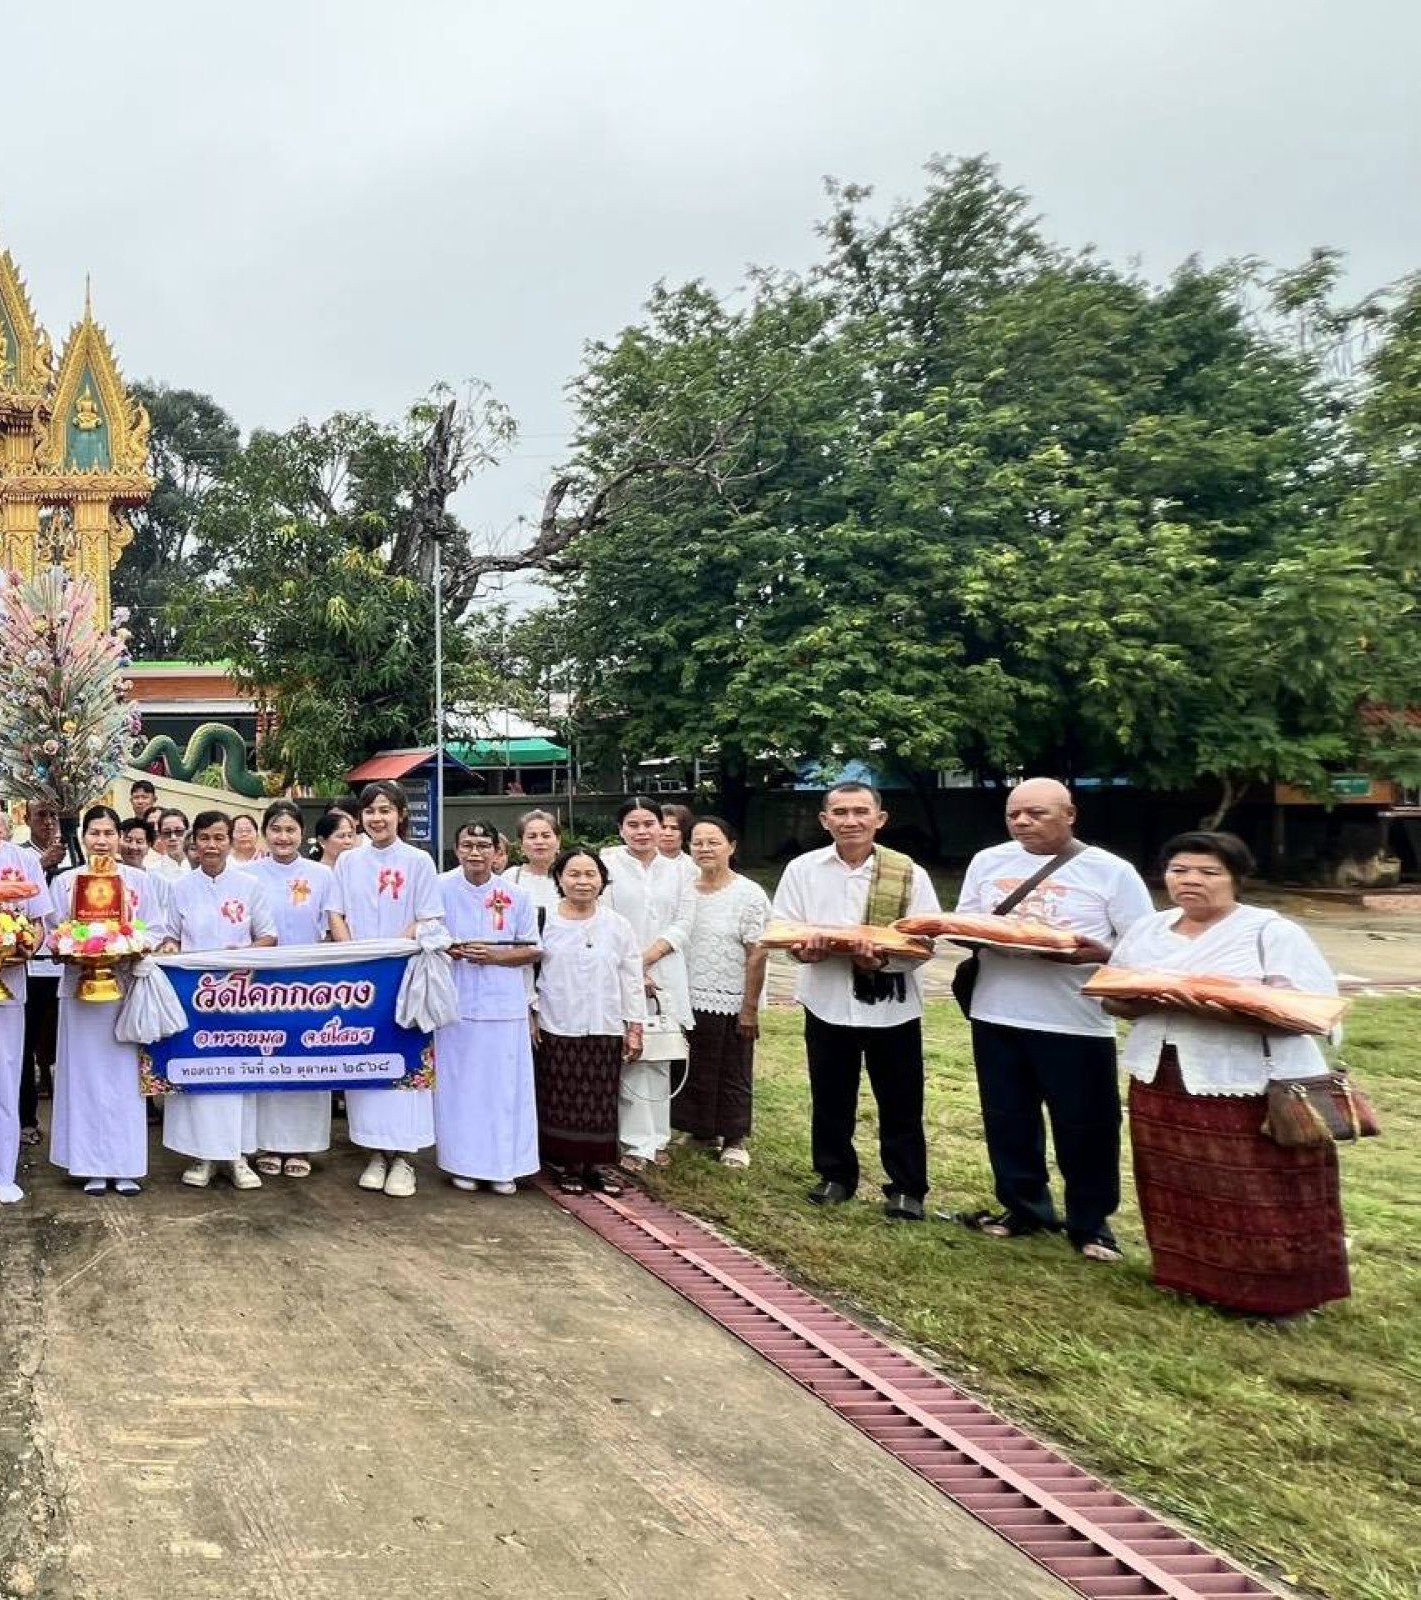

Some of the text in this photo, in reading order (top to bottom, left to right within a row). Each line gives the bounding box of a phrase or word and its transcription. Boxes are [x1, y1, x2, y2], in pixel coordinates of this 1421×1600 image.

[192, 969, 375, 1013] วัดโคกกลาง
[194, 1017, 375, 1055] อ.ทรายมูล จ.ยโสธร
[239, 1058, 264, 1075] วันที่
[297, 1063, 338, 1079] ตุลาคม
[342, 1059, 390, 1073] ๒๕๖๘
